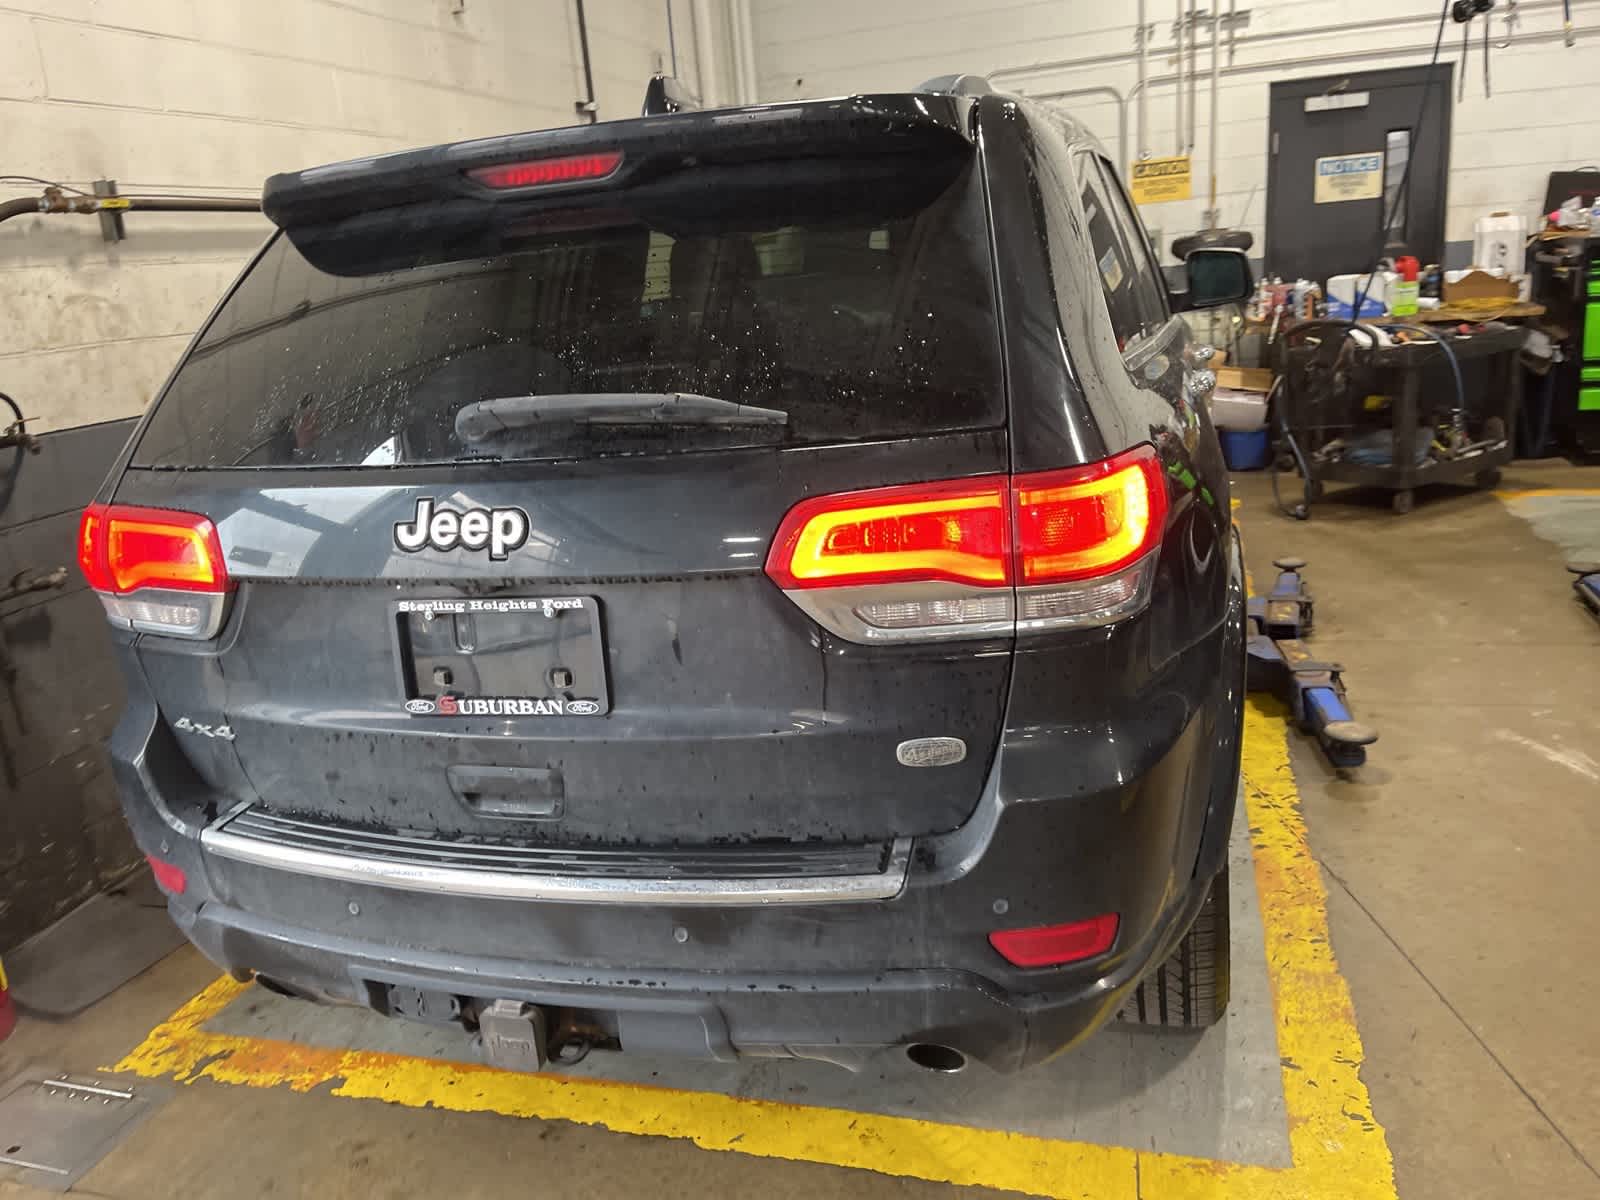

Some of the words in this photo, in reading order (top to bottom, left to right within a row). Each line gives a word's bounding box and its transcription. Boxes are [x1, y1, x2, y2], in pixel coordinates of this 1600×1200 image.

[1134, 159, 1190, 179] CAUTION
[1321, 157, 1378, 174] NOTICE
[394, 497, 528, 560] Jeep
[398, 600, 465, 612] Sterling
[469, 599, 537, 610] Heights
[541, 598, 583, 610] Ford
[407, 700, 433, 714] Ford
[438, 697, 563, 715] SUBURBAN
[568, 700, 595, 714] Ford
